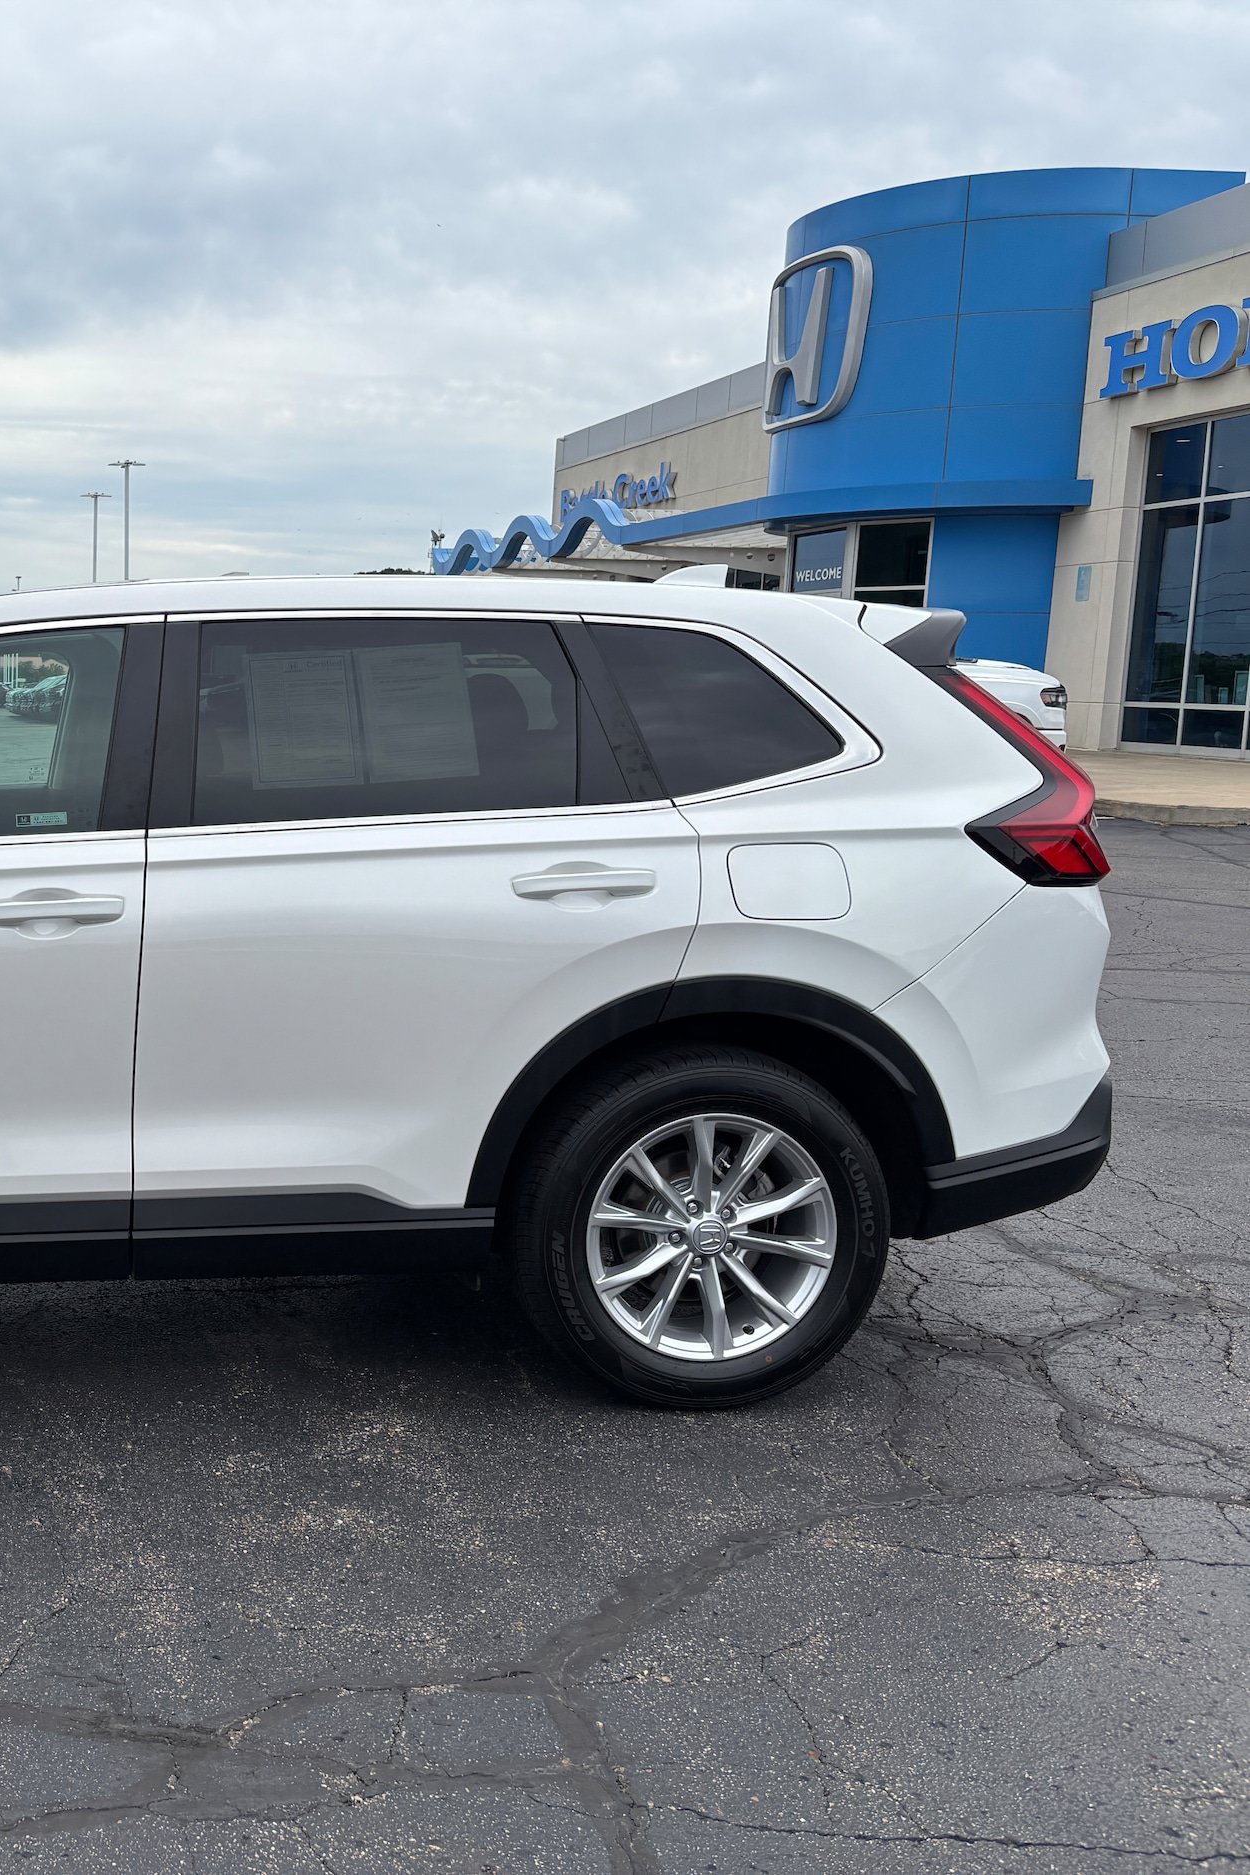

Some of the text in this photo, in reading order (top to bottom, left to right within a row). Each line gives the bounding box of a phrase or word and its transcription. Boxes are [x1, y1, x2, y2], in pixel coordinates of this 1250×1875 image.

[1099, 296, 1250, 399] HO
[613, 461, 676, 509] Creek
[795, 566, 842, 582] WELCOME
[840, 1147, 875, 1237] KUMHO
[551, 1230, 596, 1341] CRUGEN
